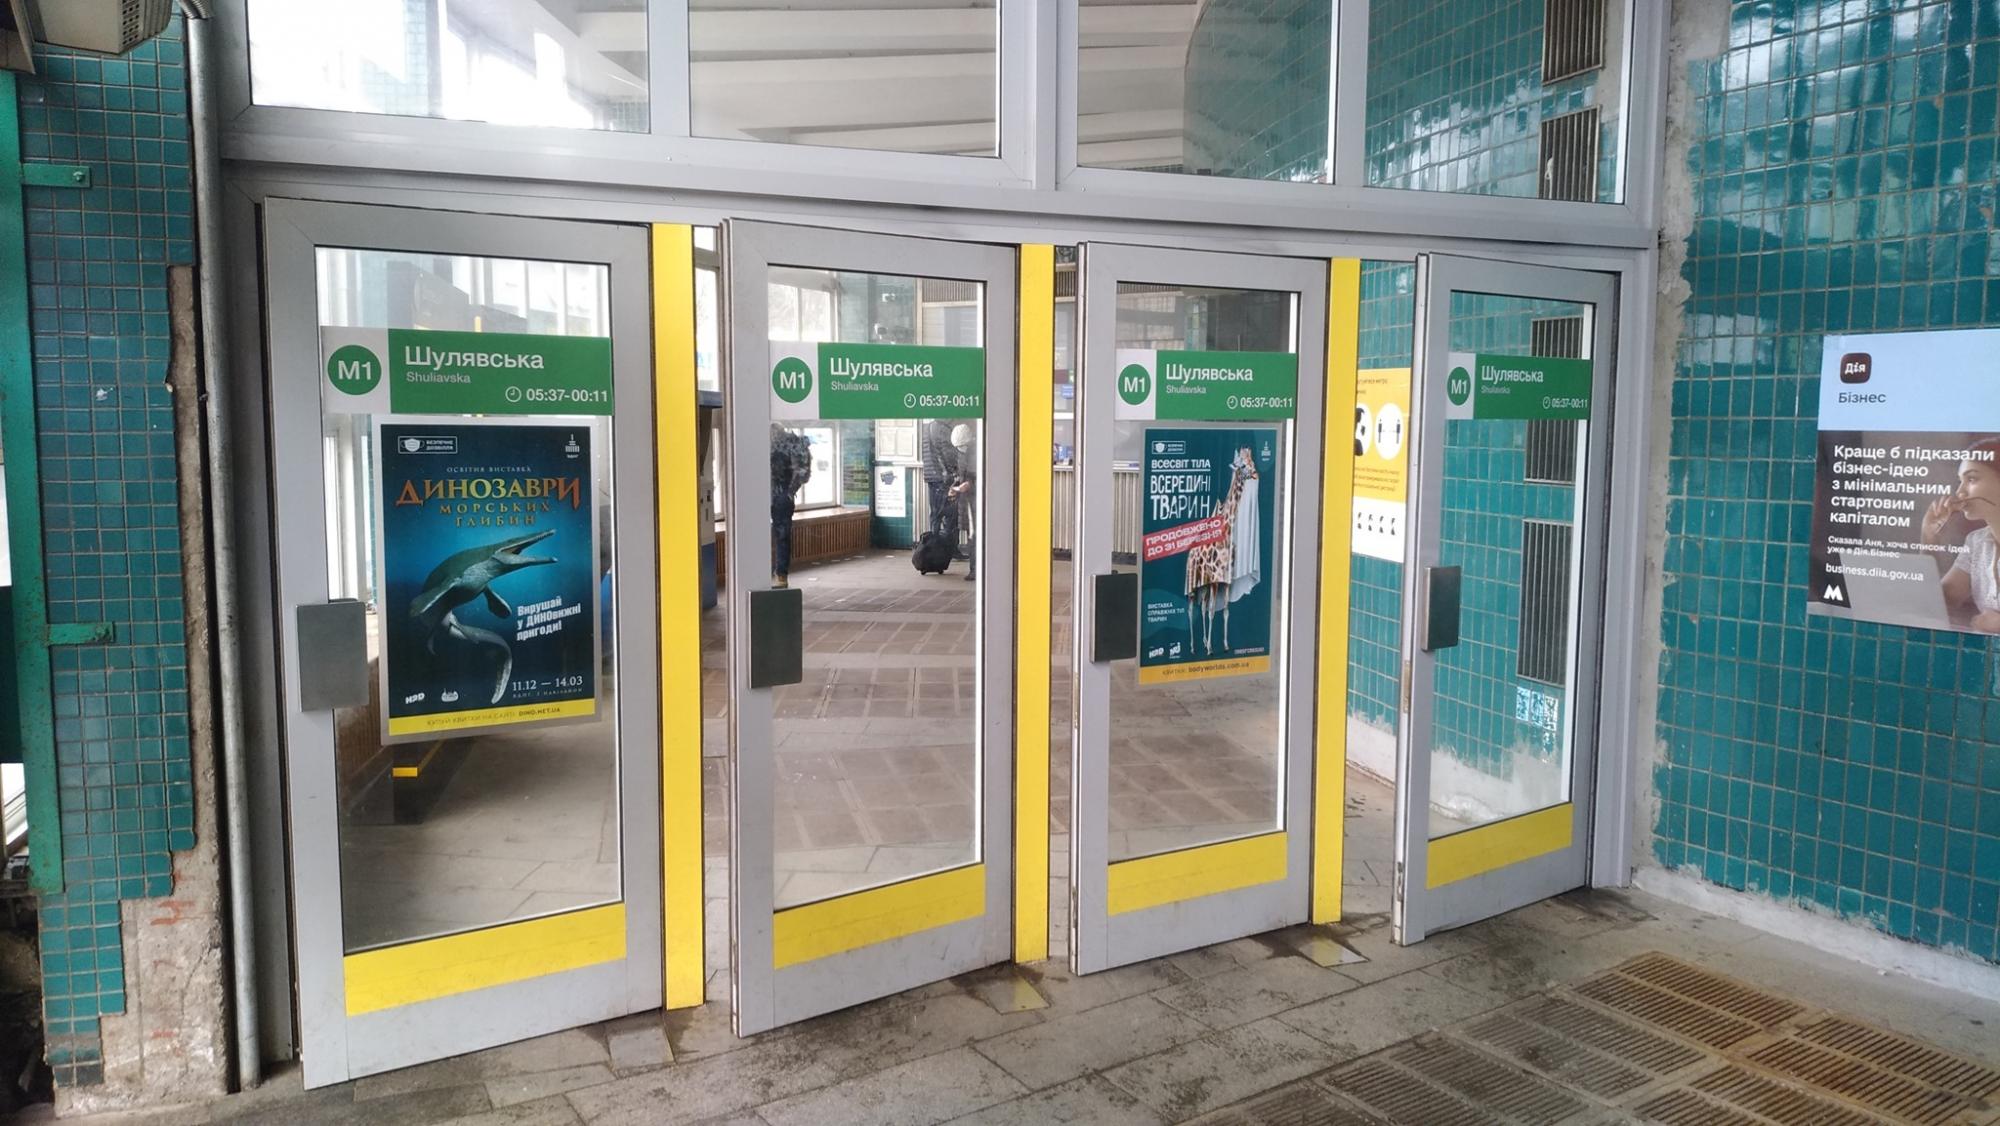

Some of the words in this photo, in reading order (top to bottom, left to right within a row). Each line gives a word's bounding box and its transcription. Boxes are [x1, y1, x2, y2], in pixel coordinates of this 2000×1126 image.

[405, 346, 544, 370] Шулявська
[338, 360, 372, 381] M1
[830, 357, 933, 379] Шулявська
[1166, 363, 1253, 384] Шулявська
[1481, 365, 1544, 384] Шулявська
[1844, 362, 1866, 375] Дія
[406, 372, 471, 384] Shuliavska
[780, 371, 806, 389] M1
[831, 380, 879, 391] Shuliavska
[1124, 377, 1146, 393] M1
[526, 388, 608, 402] 05:37-00:11
[1166, 385, 1207, 394] Shuliavska
[1451, 379, 1468, 395] M1
[919, 395, 980, 407] 05:37-00:11
[1240, 397, 1293, 408] 05:37-00:11
[1551, 397, 1588, 409] 05:37-00:11
[1838, 391, 1887, 404] Бізнес
[1834, 445, 1886, 460] Краще
[1890, 445, 1901, 459] б
[1905, 446, 1995, 462] підказали
[1833, 462, 1929, 477] бізнес-ідею
[1150, 475, 1211, 494] ВСЕРЕДИНІ
[1832, 480, 1840, 490] з
[1844, 478, 1951, 495] мінімальним
[396, 477, 581, 510] ДИНОЗАВРИ
[439, 501, 550, 514] МОРСЬКИХ
[1150, 495, 1210, 520] ТВАРИН
[1831, 496, 1915, 512] стартовим
[455, 515, 536, 527] ГЛИБИН
[1830, 511, 1911, 527] капіталом
[1146, 519, 1222, 546] ПРОДОВЖЕНО
[1147, 546, 1164, 557] ДО
[1164, 541, 1176, 551] 31
[1827, 546, 1844, 554] уже
[1853, 548, 1901, 559] Дія.Бізнес
[1828, 535, 1863, 546] Сказала
[1864, 538, 1885, 548] Аня,
[1886, 541, 1908, 549] хоча
[1910, 543, 1945, 552] список
[1948, 543, 1970, 554] ідей
[1826, 563, 1924, 582] business.diia.gov.ua
[517, 595, 562, 617] Вирушай
[517, 619, 524, 630] у
[1147, 615, 1168, 623] ТВАРИН
[512, 679, 537, 691] 11.12
[555, 675, 583, 688] 14.03
